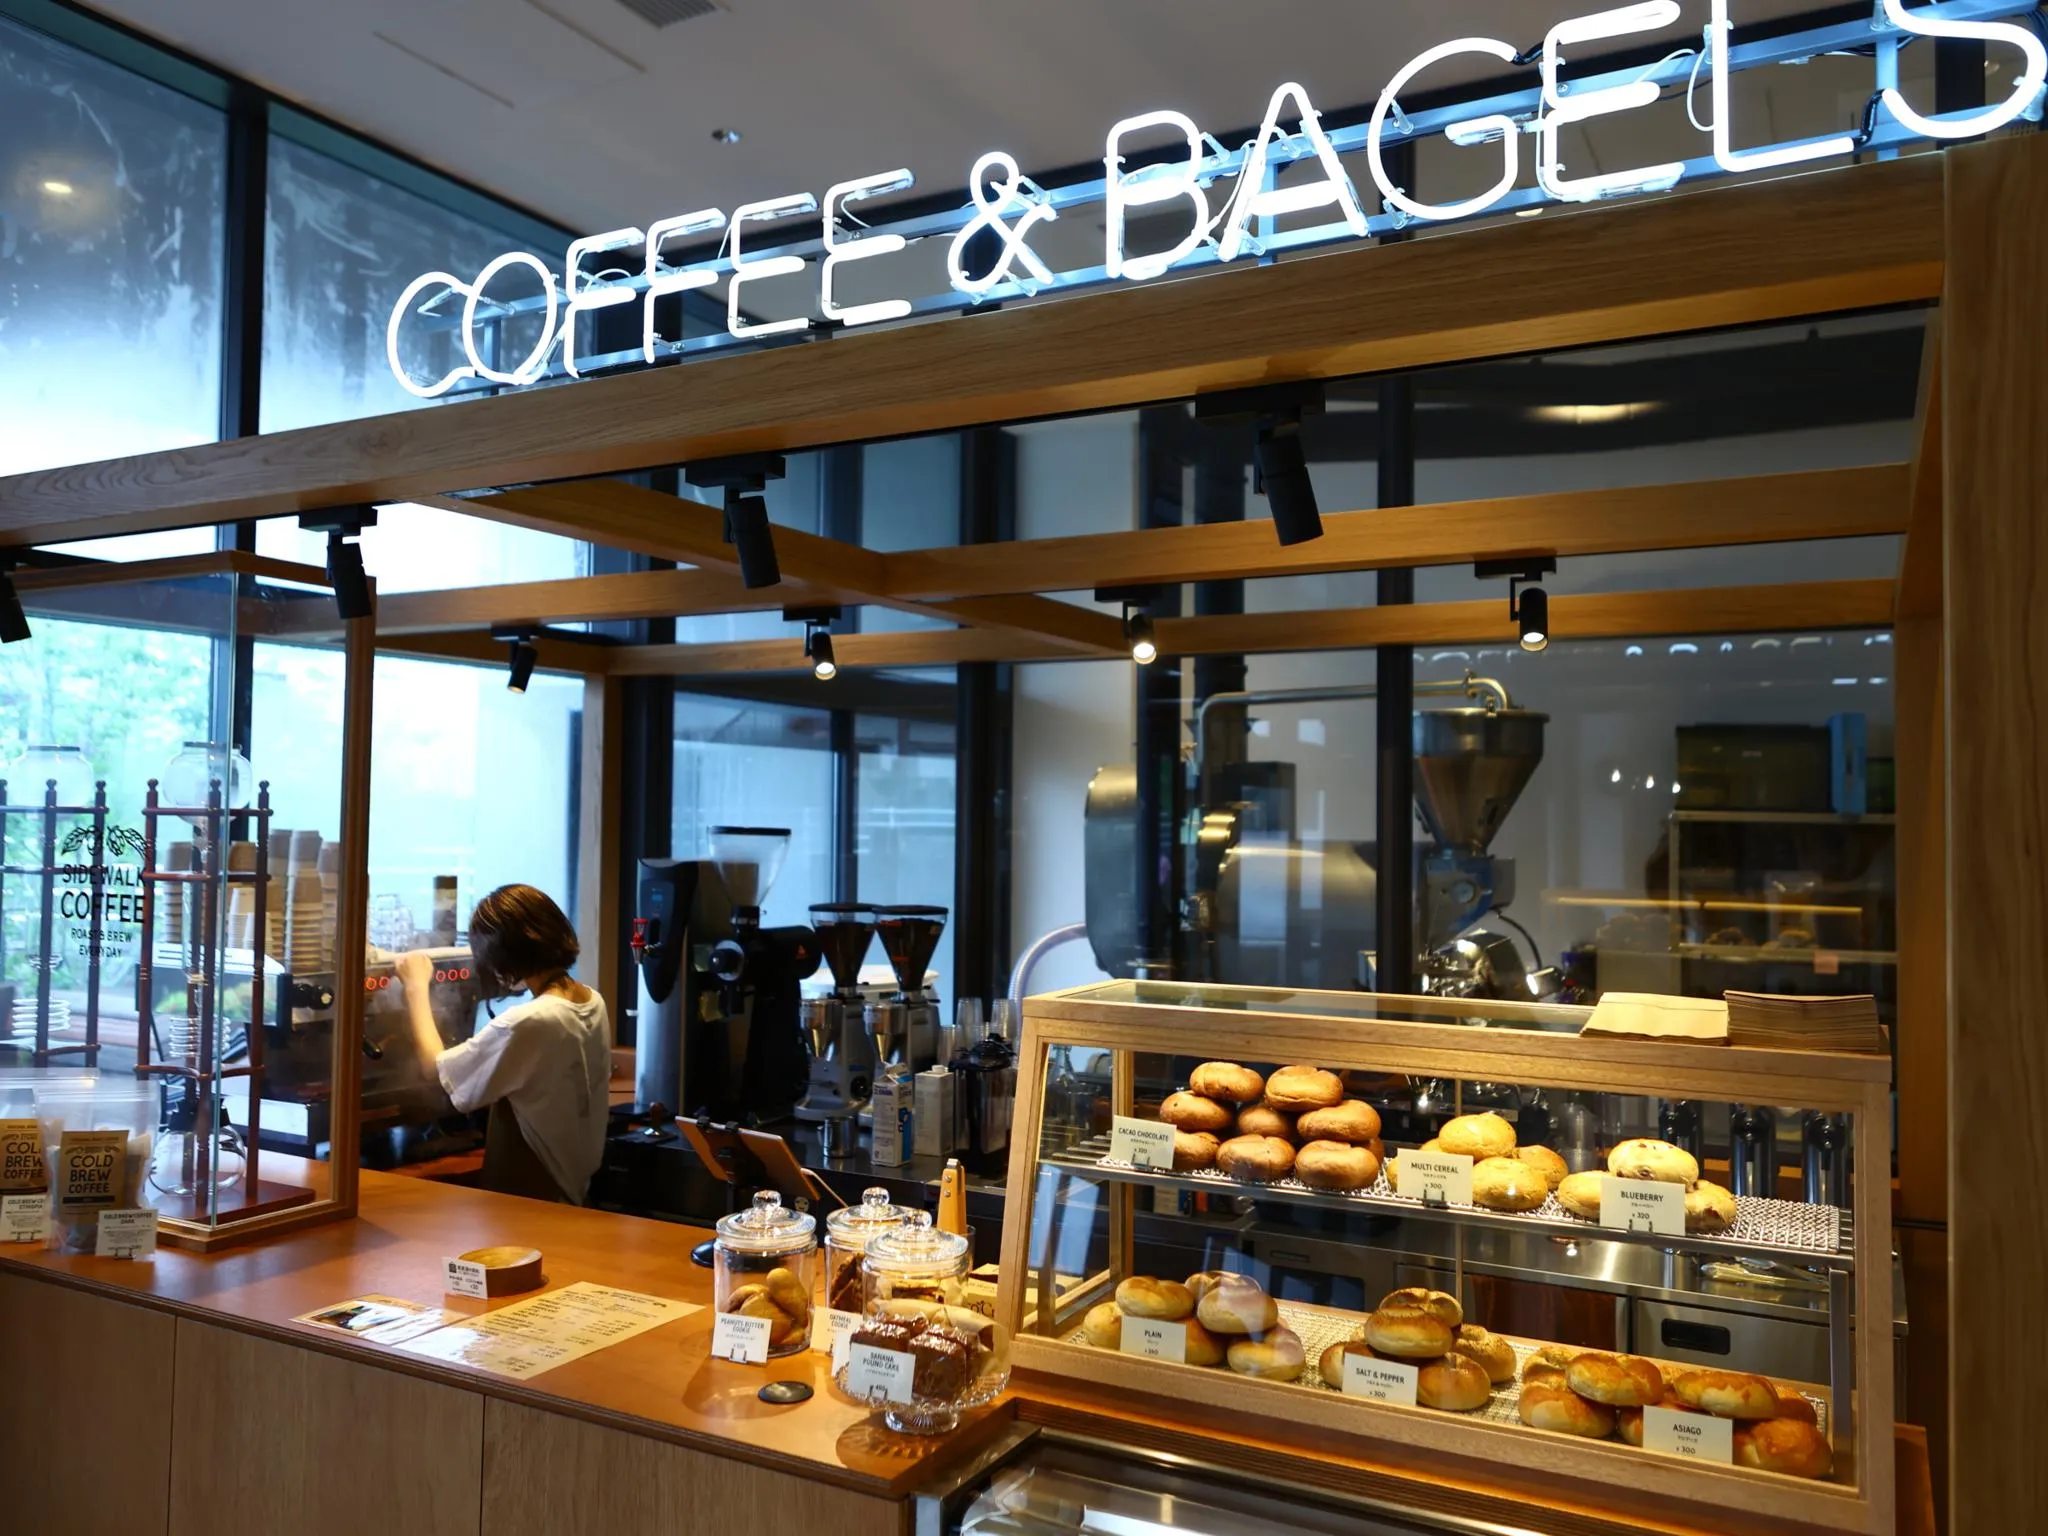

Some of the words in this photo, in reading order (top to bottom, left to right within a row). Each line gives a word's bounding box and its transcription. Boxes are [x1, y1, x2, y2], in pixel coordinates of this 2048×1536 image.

[387, 168, 916, 398] COFFEE
[947, 150, 1057, 299] &
[1106, 0, 2048, 281] BAGELS
[61, 891, 146, 923] COFFEE
[1119, 1128, 1136, 1136] CACAO
[1137, 1131, 1168, 1141] CHOCOLATE
[6, 1142, 41, 1154] COL
[70, 1155, 113, 1168] COLD
[1411, 1162, 1432, 1171] MULTI
[1434, 1164, 1459, 1174] CEREAL
[69, 1169, 111, 1182] BREW
[68, 1183, 110, 1194] COFFEE
[1621, 1191, 1664, 1202] BLUEBERRY
[1144, 1329, 1162, 1339] PLAIN
[1356, 1367, 1371, 1377] SALT
[1380, 1372, 1405, 1385] PEPPER
[1673, 1423, 1702, 1436] ASIAGO
